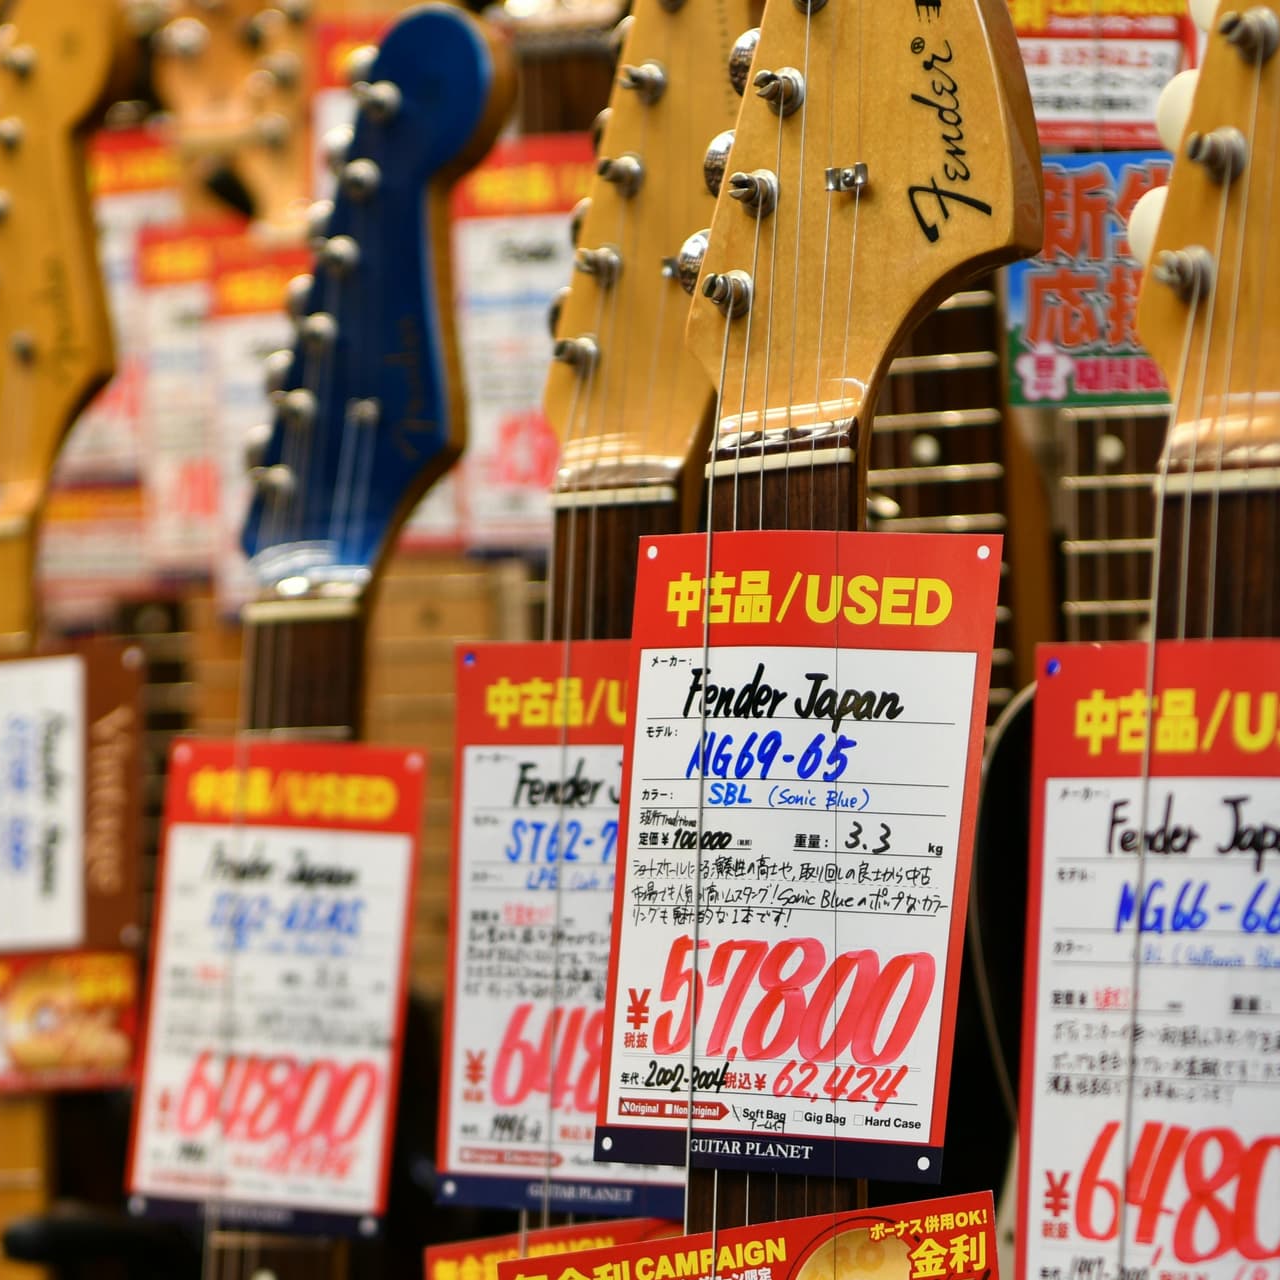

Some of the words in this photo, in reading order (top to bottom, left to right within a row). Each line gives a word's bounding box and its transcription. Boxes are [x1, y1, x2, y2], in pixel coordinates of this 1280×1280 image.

[908, 39, 992, 243] Fender
[666, 570, 953, 627] 中古品/USED
[683, 663, 787, 719] Fender
[795, 673, 904, 733] Japan
[513, 757, 603, 807] Fender
[708, 782, 752, 807] SBL
[844, 821, 891, 854] 3.3
[928, 843, 943, 855] kg
[1106, 793, 1199, 856] Fender
[626, 988, 650, 1029] ¥
[624, 1032, 648, 1048] 税抜
[644, 1060, 730, 1093] 2002-2004
[772, 1059, 908, 1112] 62,424
[629, 1103, 659, 1114] Original
[673, 1103, 719, 1117] NonOriginal
[743, 1108, 764, 1120] Soft
[766, 1110, 786, 1122] Bag
[804, 1112, 823, 1124] Gig
[825, 1114, 846, 1126] Bag
[865, 1117, 890, 1128] Hard
[894, 1118, 921, 1129] Case
[690, 1139, 741, 1154] GUITAR
[745, 1141, 813, 1160] PLANET
[579, 1187, 634, 1202] PLANET
[910, 1231, 986, 1279] 金利
